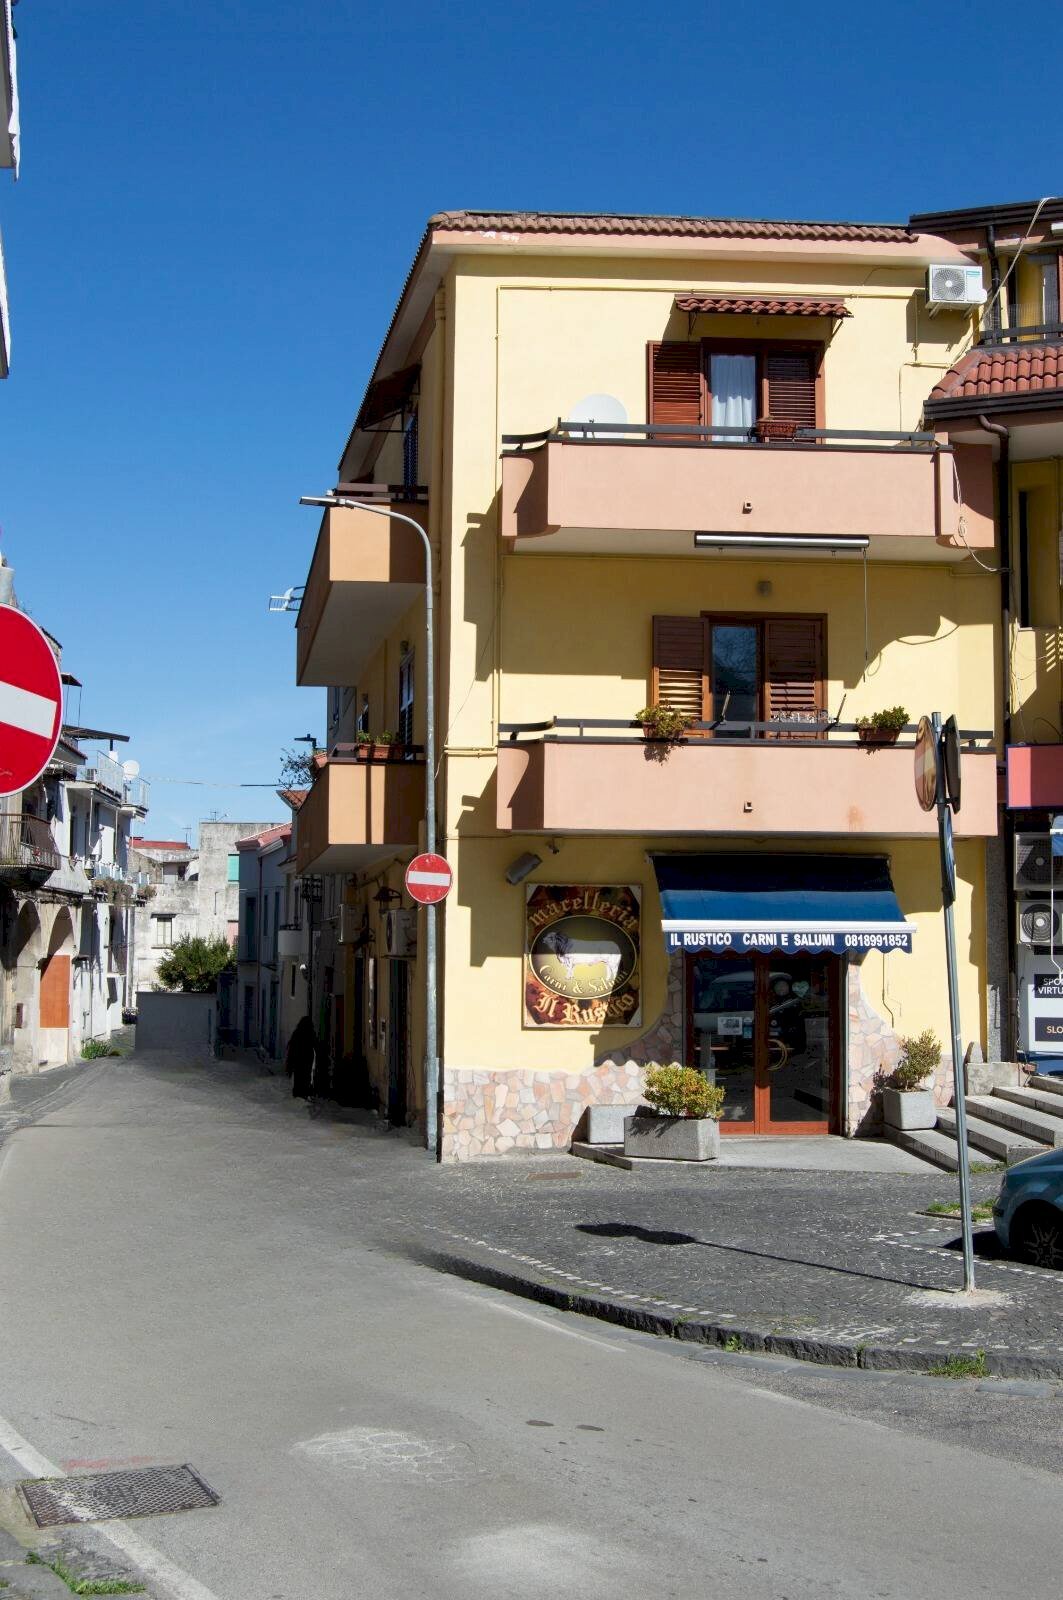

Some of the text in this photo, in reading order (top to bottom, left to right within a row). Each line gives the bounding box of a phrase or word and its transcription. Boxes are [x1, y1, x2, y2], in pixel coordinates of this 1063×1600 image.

[670, 933, 908, 947] IL RUSTICO CARNI E SALUMI 0818991852
[539, 964, 628, 994] Carni & Salumi
